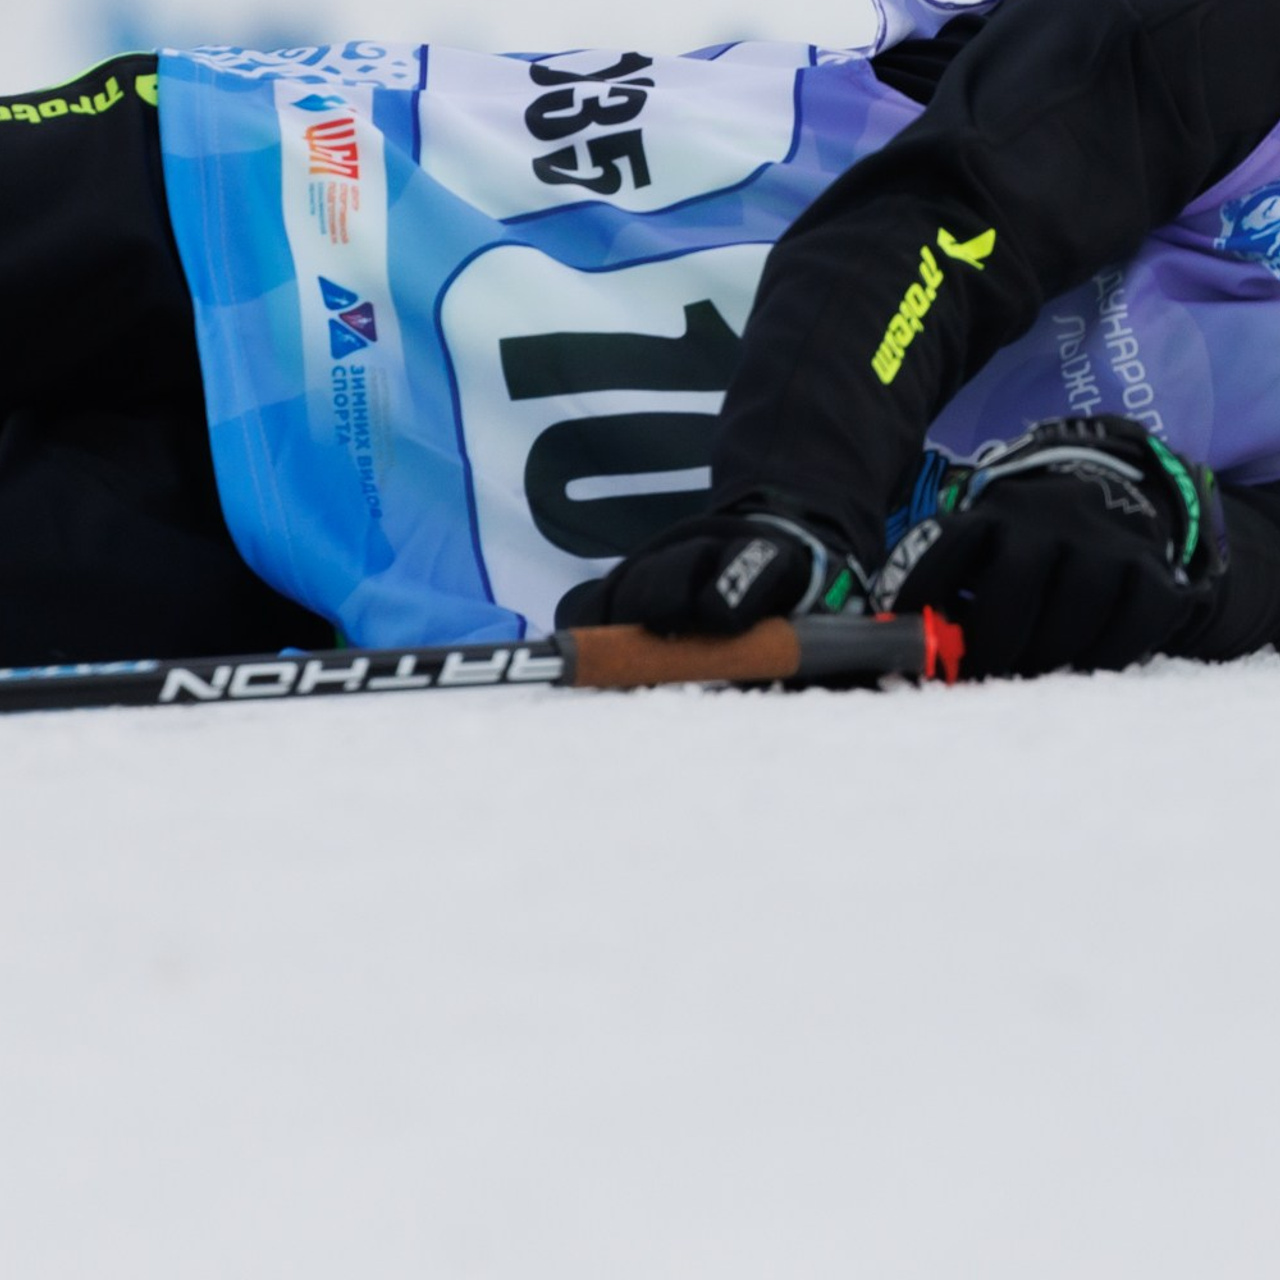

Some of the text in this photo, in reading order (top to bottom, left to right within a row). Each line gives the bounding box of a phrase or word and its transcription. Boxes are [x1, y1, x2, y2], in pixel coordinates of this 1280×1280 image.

[331, 365, 352, 447] СПОРТА
[350, 365, 371, 451] ЗИМНИХ
[356, 455, 383, 520] ВИДОВ
